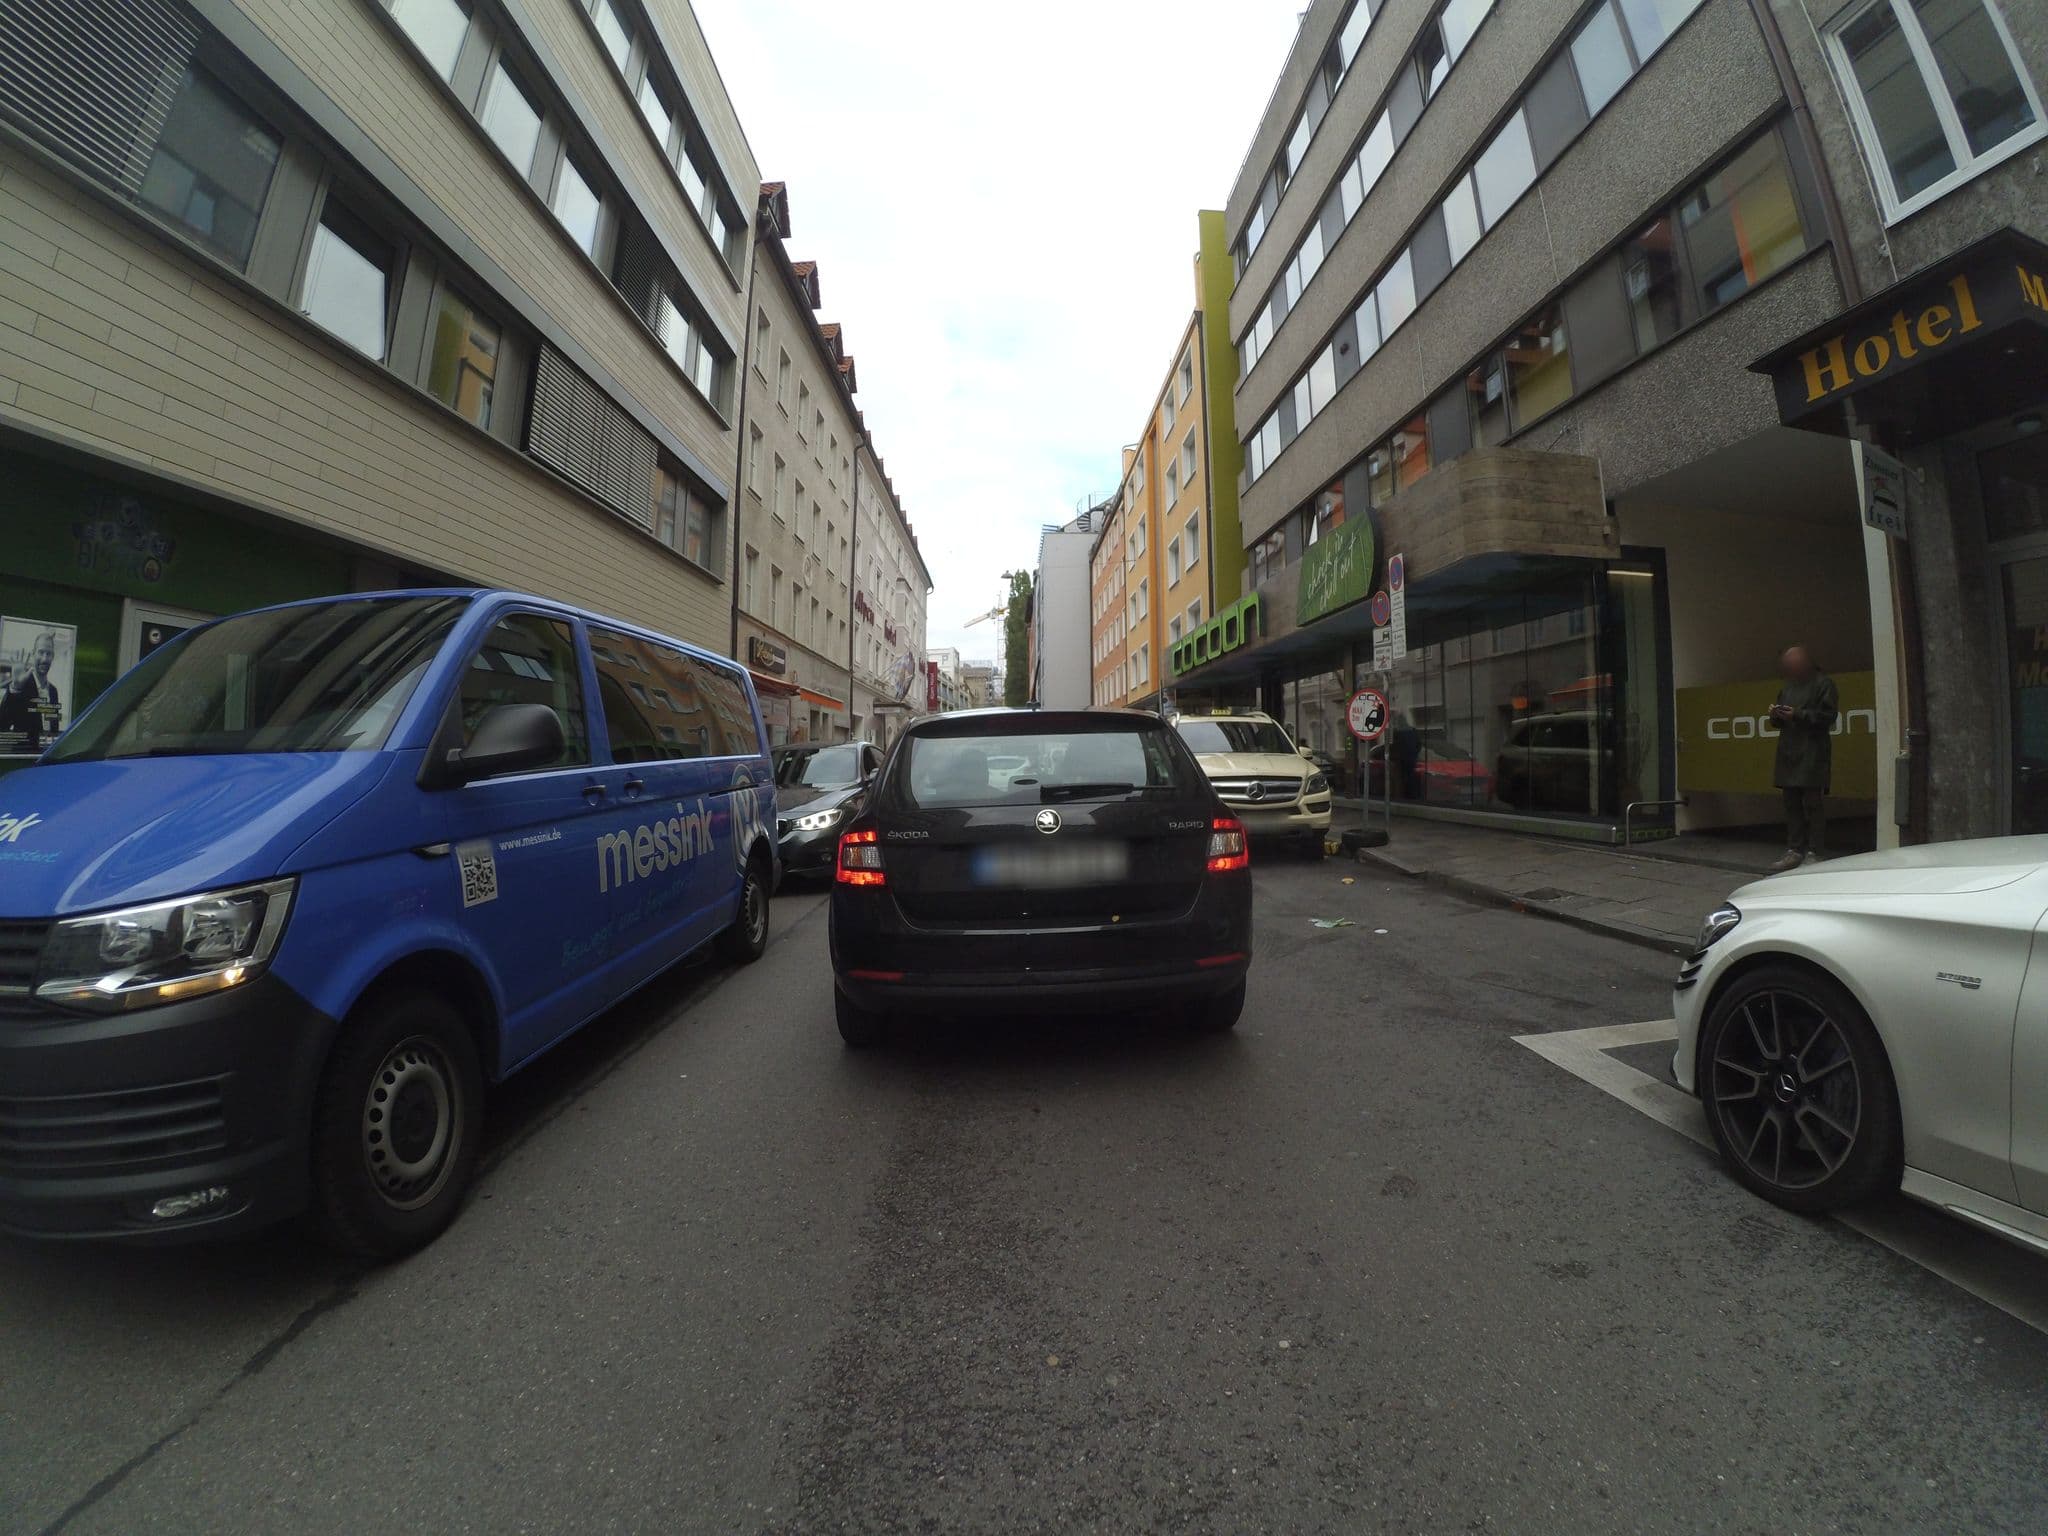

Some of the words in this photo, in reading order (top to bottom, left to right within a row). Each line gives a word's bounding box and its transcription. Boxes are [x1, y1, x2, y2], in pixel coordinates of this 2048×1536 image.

[1799, 272, 1984, 404] Hotel
[1170, 591, 1260, 677] cocoon
[1707, 709, 1876, 740] cocn
[500, 827, 562, 851] www.messink.de
[597, 798, 714, 893] messink
[1168, 820, 1205, 831] RAPID
